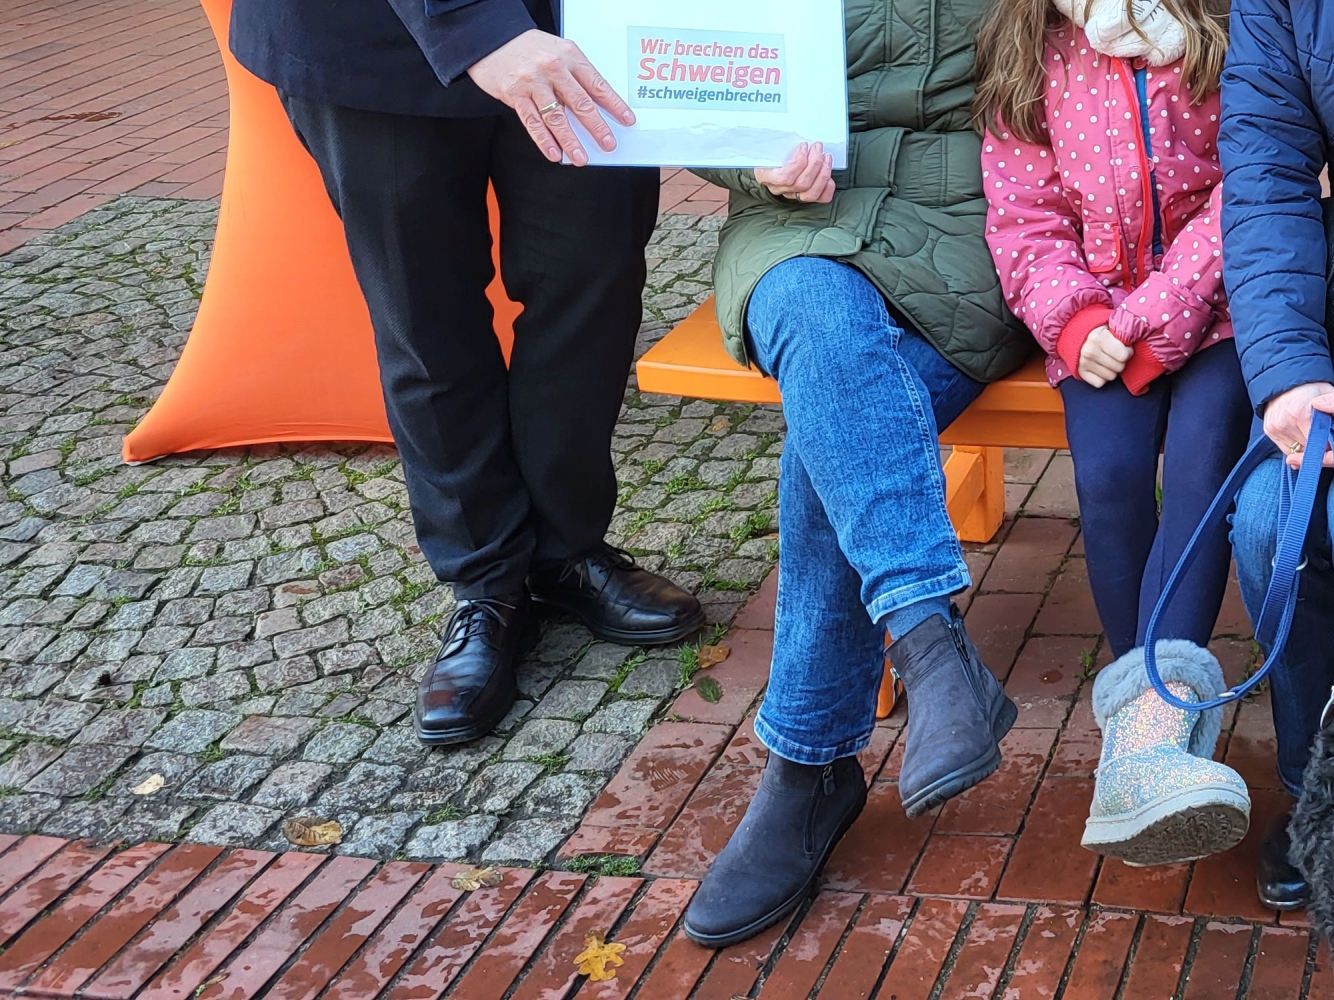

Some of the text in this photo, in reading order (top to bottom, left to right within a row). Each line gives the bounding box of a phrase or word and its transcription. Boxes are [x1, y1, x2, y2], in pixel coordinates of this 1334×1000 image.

[641, 38, 779, 60] Wir brechen das
[637, 57, 781, 89] Schweigen
[637, 85, 782, 103] #schweigenbrechen
